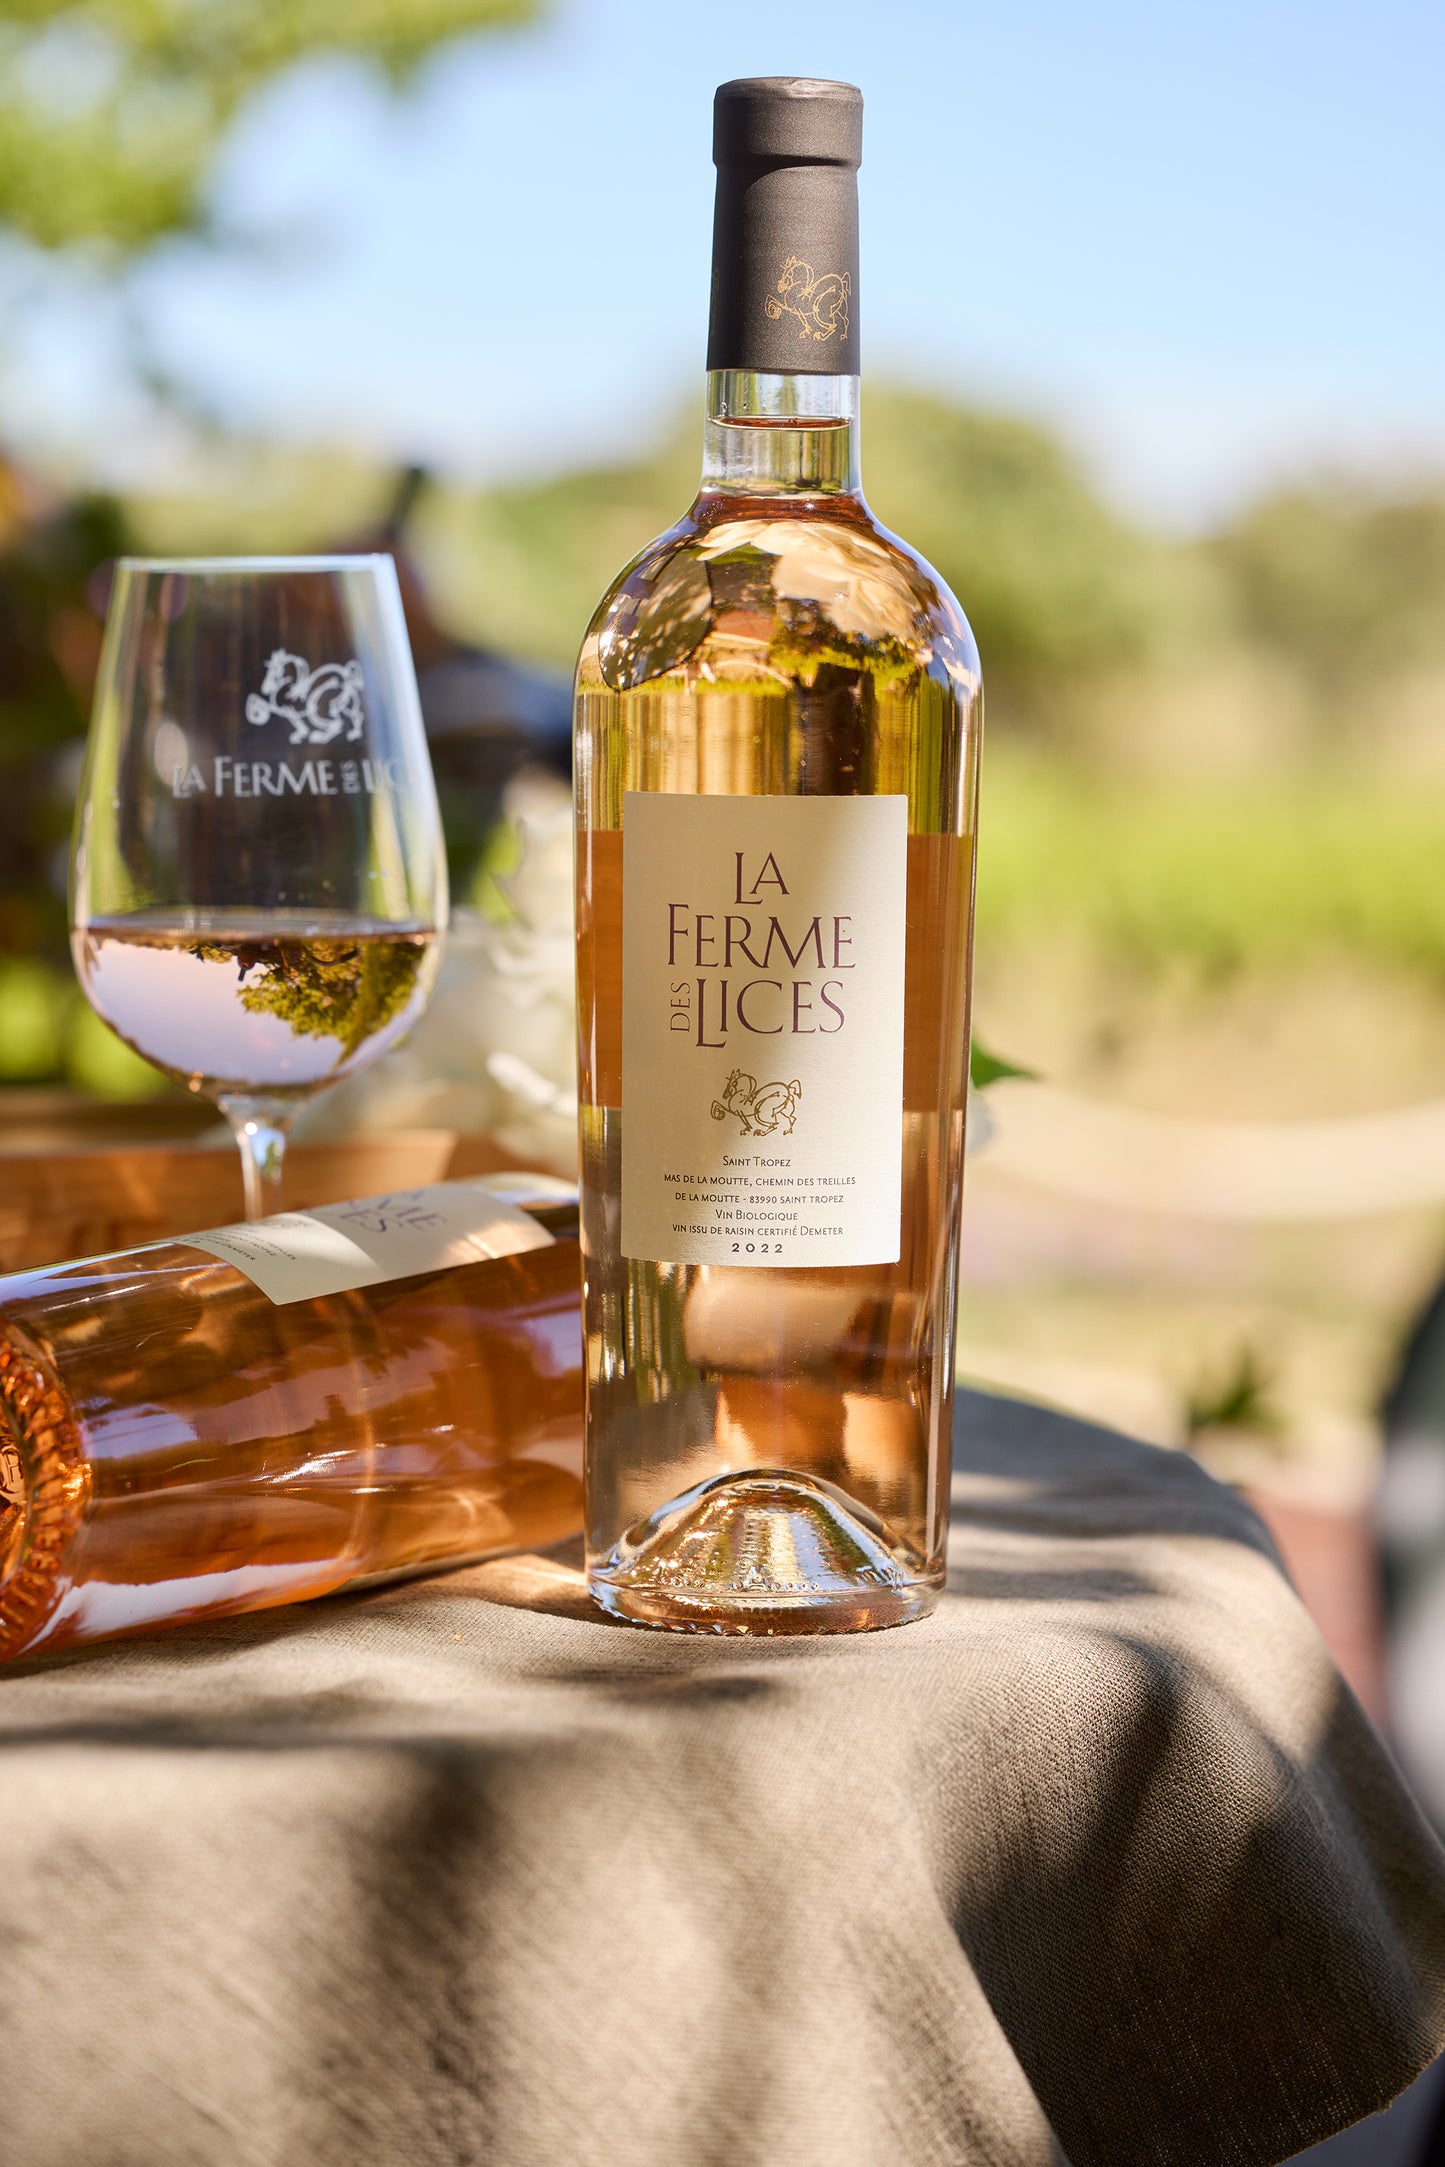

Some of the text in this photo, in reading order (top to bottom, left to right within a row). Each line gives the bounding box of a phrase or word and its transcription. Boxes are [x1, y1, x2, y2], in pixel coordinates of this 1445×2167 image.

[172, 762, 206, 798] LA
[214, 755, 338, 798] FERME
[734, 851, 790, 905] LA
[667, 903, 856, 969] FERME
[670, 978, 845, 1048] DES LICES
[722, 1155, 791, 1167] SAINT TROPEZ
[664, 1173, 856, 1188] MAS DE LA MOUTTE, CHEMIN DES TREILLES
[675, 1192, 687, 1201] DE
[689, 1193, 700, 1202] LA
[701, 1194, 740, 1203] MOUTTE
[749, 1195, 777, 1204] 83990
[780, 1195, 807, 1204] SAINT
[810, 1195, 844, 1204] TROPEZ
[715, 1209, 798, 1221] VIN BIOLOGIQUE
[672, 1224, 844, 1237] VIN ISSU DE RAISIN CERTIFIÉ DEMETER
